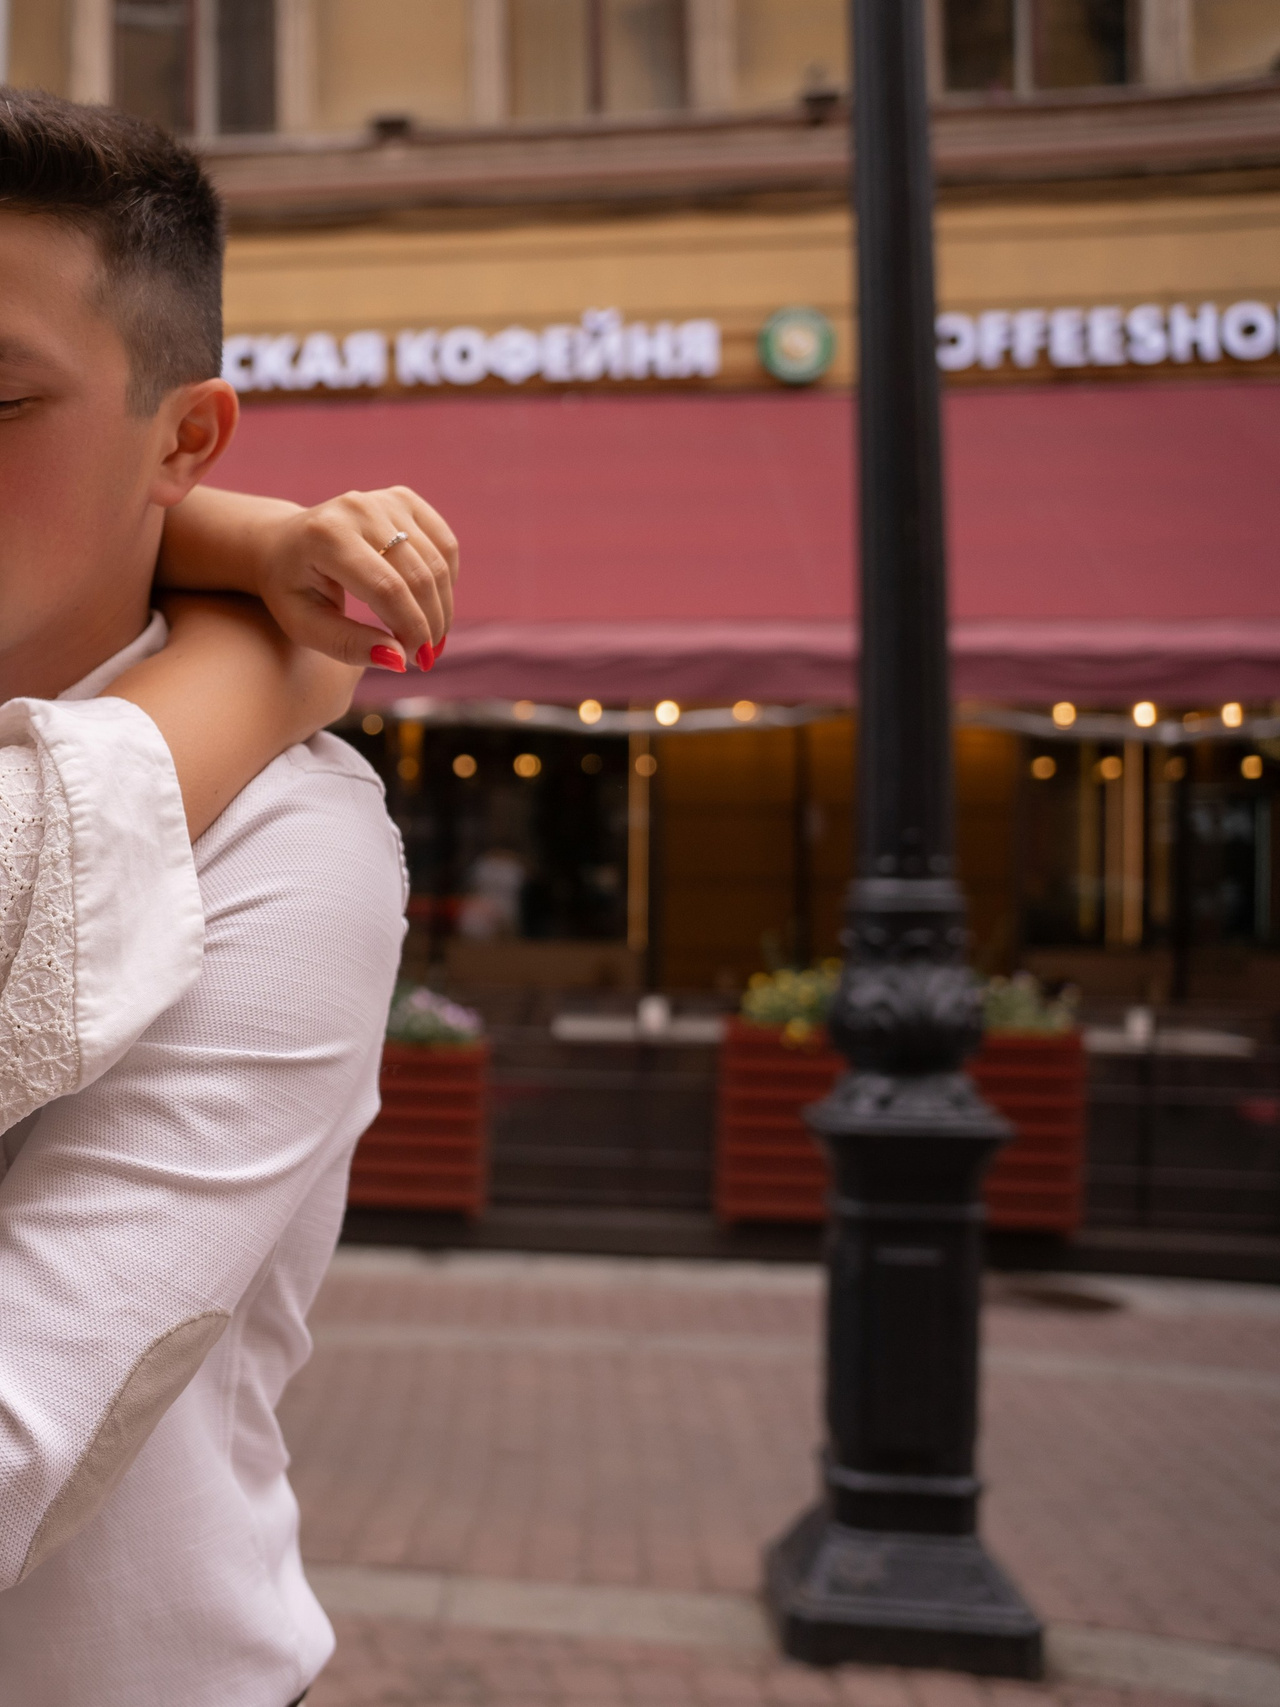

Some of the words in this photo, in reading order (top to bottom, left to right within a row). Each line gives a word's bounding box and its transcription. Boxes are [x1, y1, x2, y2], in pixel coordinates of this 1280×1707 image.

[221, 329, 387, 390] СКАЯ
[395, 305, 720, 384] КОФЕЙНЯ
[936, 301, 1280, 369] OFFEESHO
